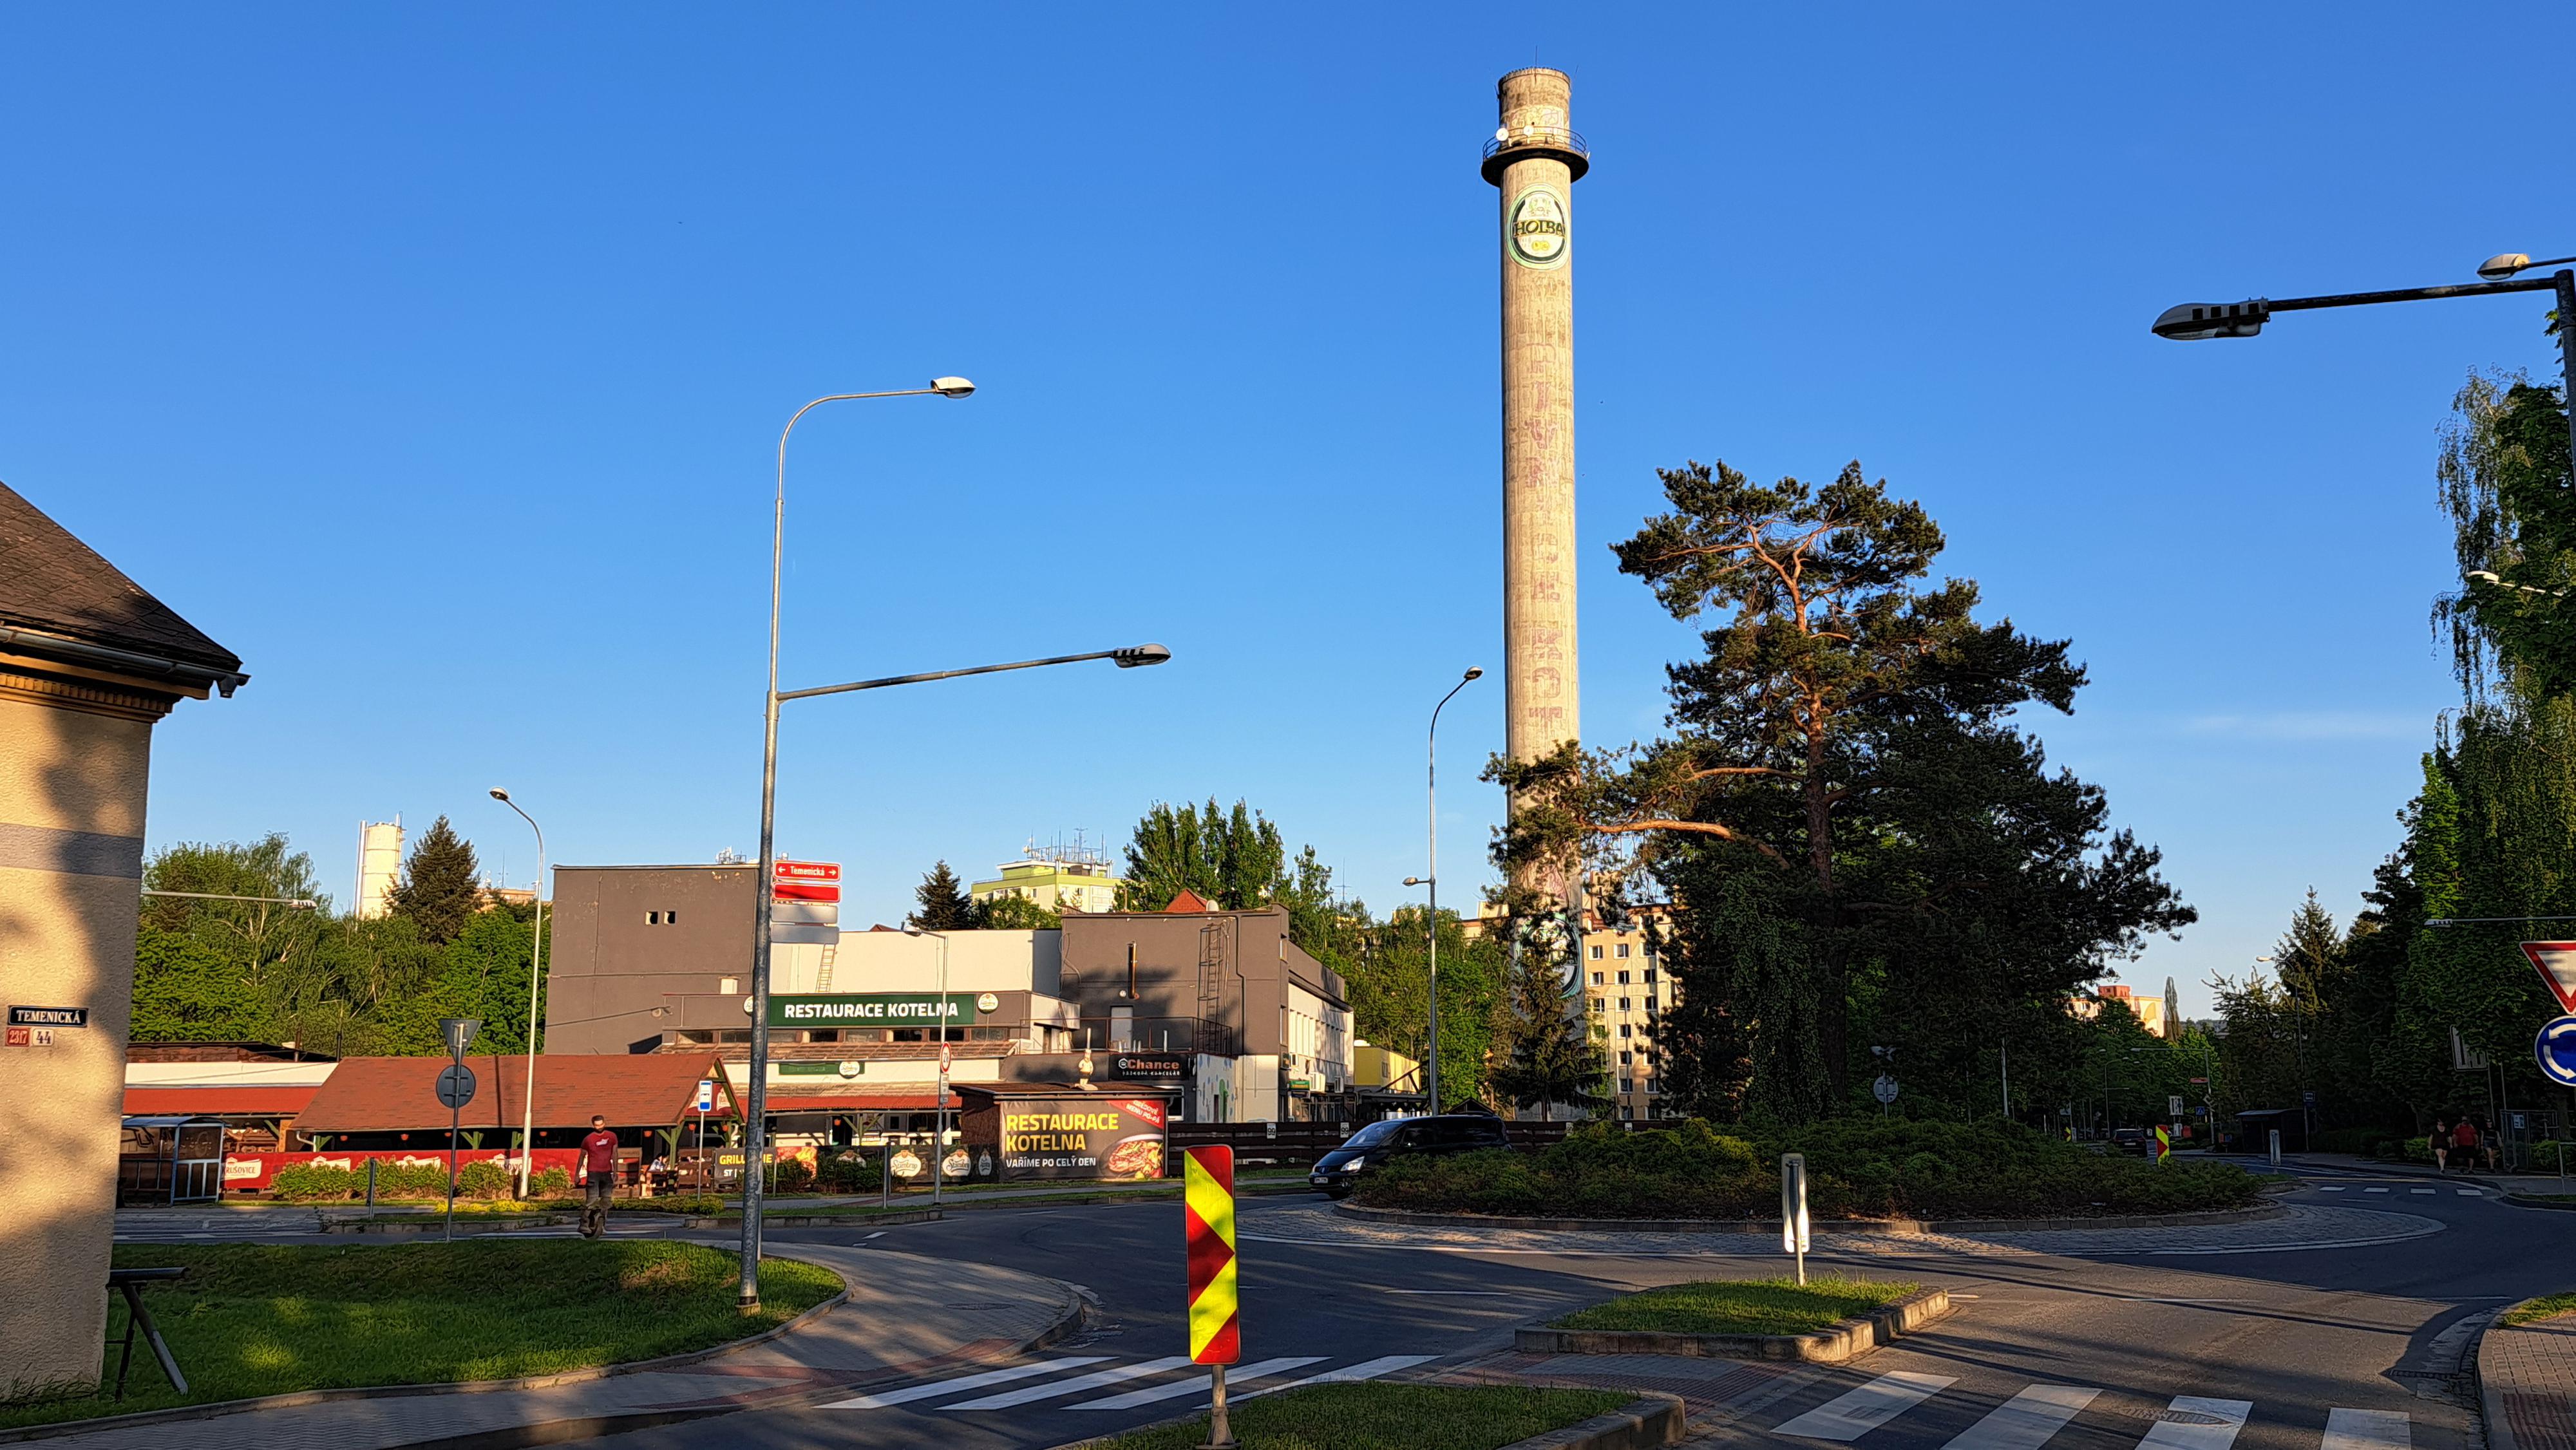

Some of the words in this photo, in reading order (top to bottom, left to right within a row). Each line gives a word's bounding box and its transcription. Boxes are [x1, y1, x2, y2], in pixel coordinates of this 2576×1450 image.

[1513, 220, 1566, 238] HOLBA
[790, 865, 825, 876] Temenická
[16, 1010, 81, 1024] TEMENICKÁ
[785, 1004, 883, 1018] RESTAURACE
[887, 1002, 958, 1017] KOTELNA
[9, 1030, 27, 1044] 2317
[36, 1031, 51, 1044] 44
[1128, 1059, 1180, 1069] Chance
[1006, 1113, 1119, 1131] RESTAURACE
[1006, 1133, 1086, 1151] KOTELNA
[1006, 1156, 1040, 1167] VAŘÍME
[1042, 1158, 1054, 1167] PO
[1056, 1155, 1077, 1166] CELÝ
[1078, 1157, 1096, 1166] DEN
[225, 1165, 256, 1174] RUŠOVICE
